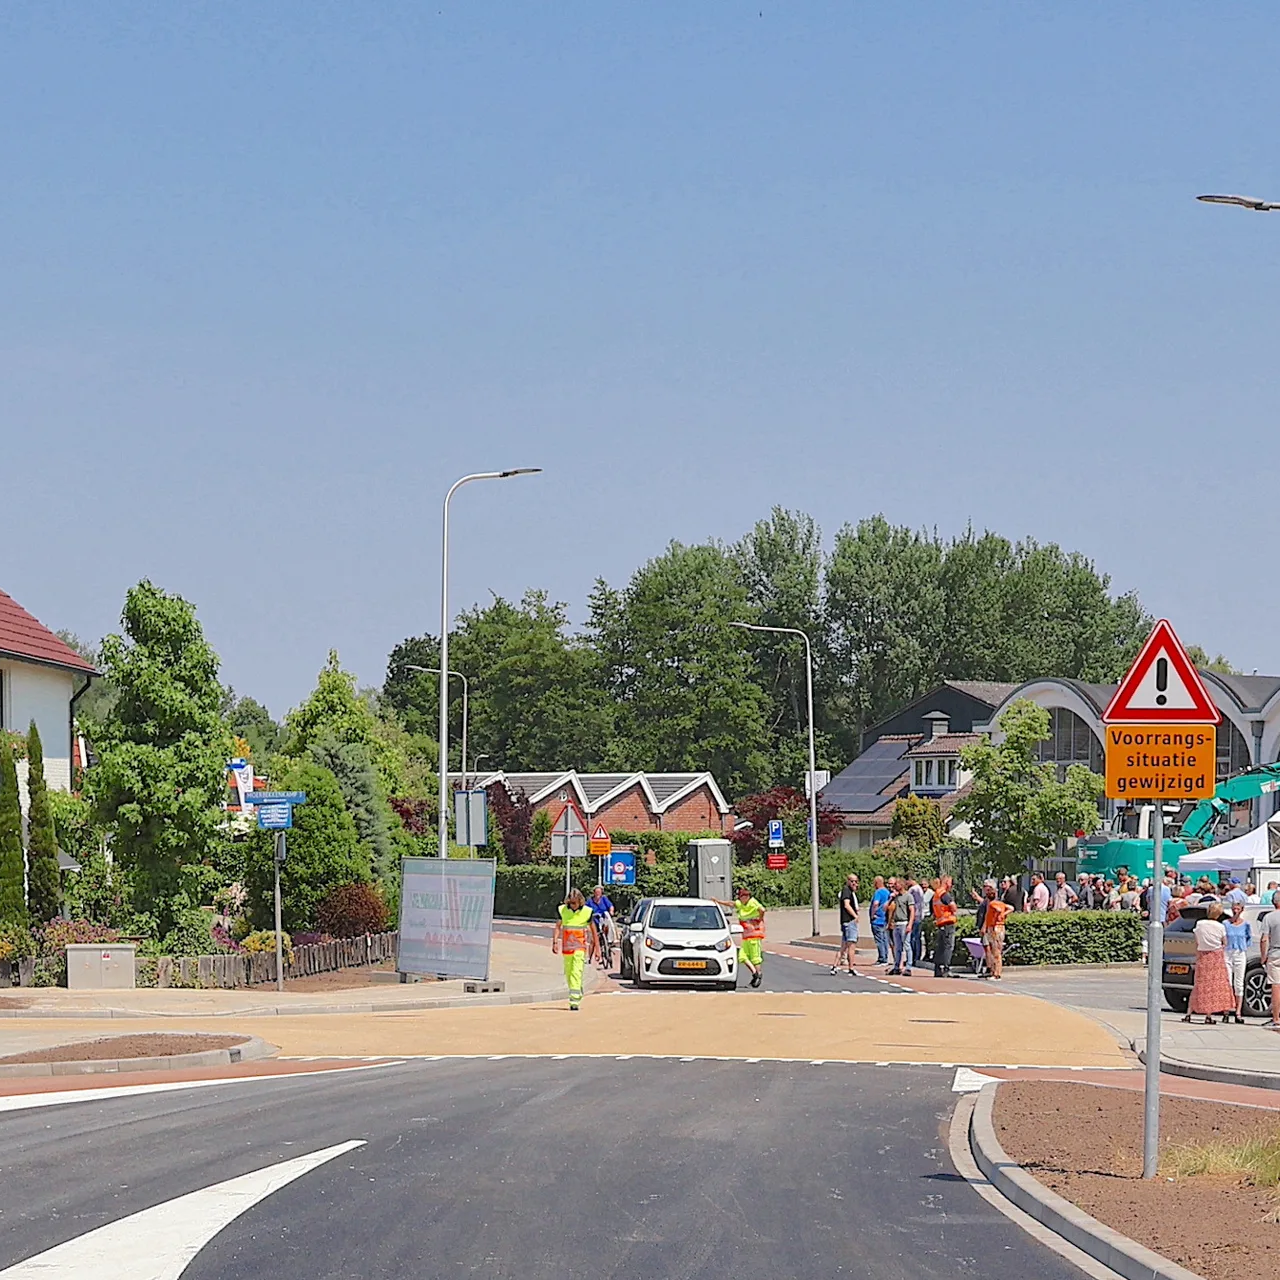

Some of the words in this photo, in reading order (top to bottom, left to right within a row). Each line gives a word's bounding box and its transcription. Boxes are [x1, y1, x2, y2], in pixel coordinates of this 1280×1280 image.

[1111, 730, 1212, 749] Voorrangs-
[1126, 752, 1196, 767] situatie
[1117, 774, 1205, 792] gewijzigd
